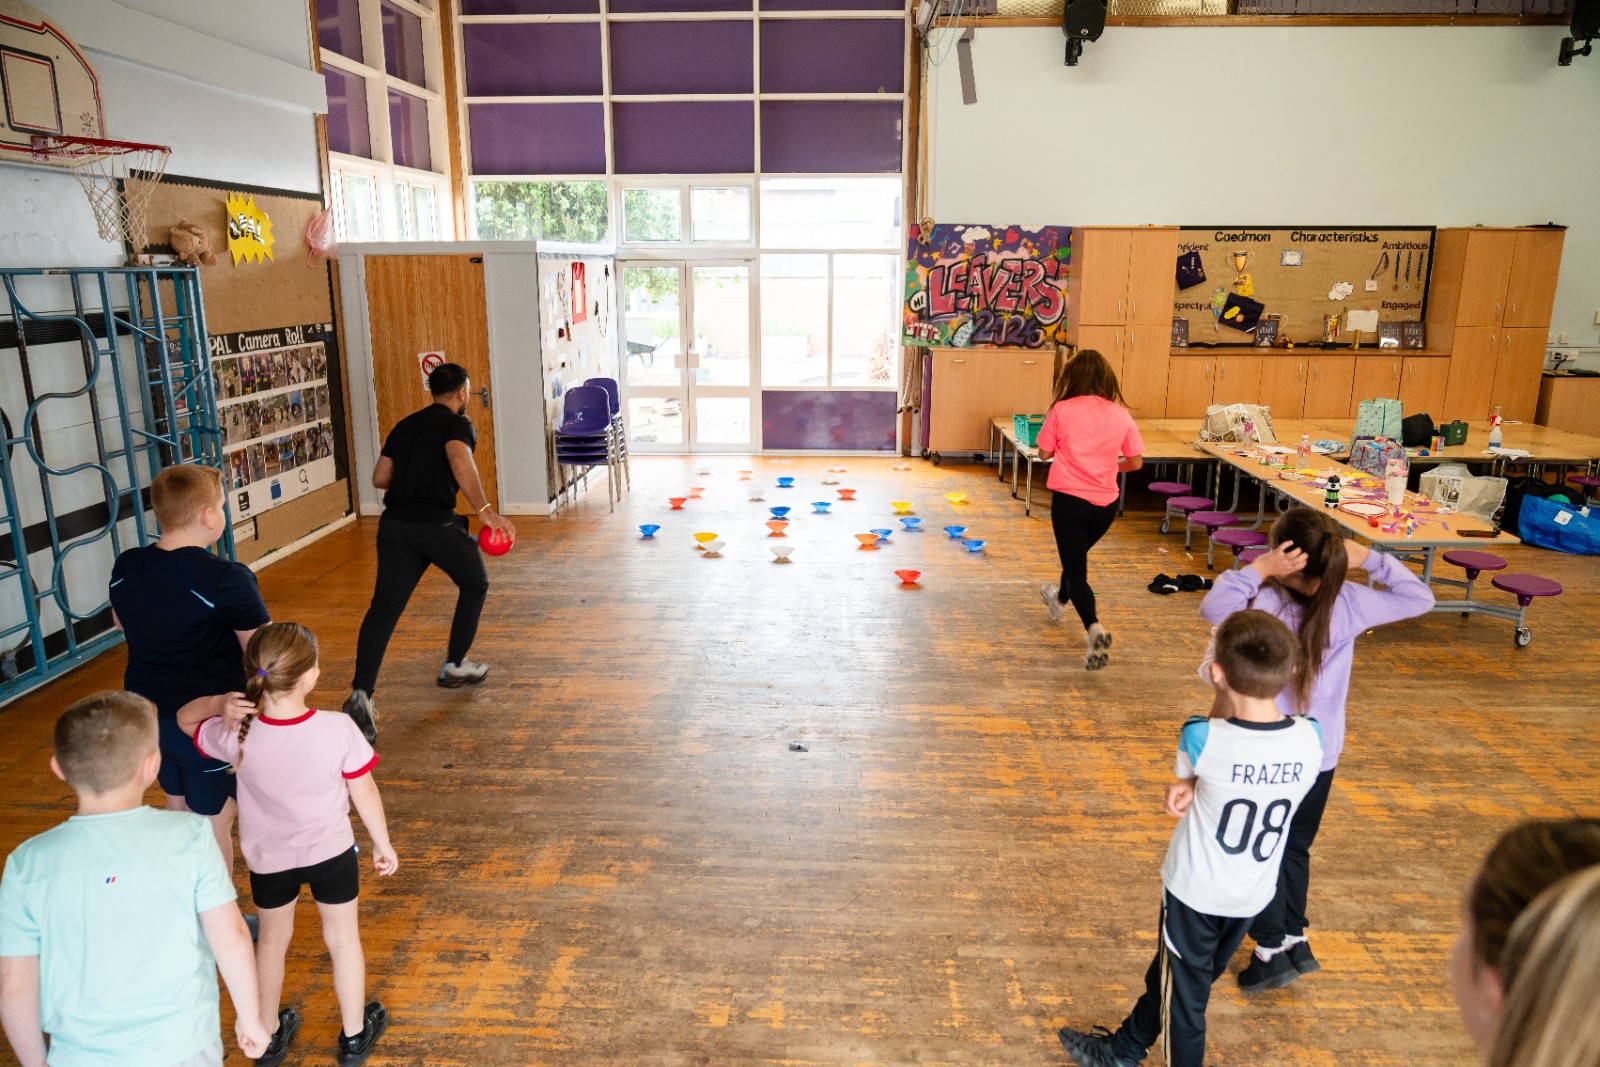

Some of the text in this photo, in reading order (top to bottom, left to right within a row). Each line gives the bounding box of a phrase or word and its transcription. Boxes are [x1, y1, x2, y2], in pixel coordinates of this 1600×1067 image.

[229, 212, 265, 245] OPAL
[1214, 231, 1379, 243] Caedmon Characteristics
[1177, 243, 1209, 252] nfident
[1381, 241, 1428, 250] Ambitious
[926, 253, 1066, 325] LEAVERS
[914, 295, 925, 307] HI
[1173, 302, 1212, 311] spectful
[1381, 301, 1421, 310] Engaged
[971, 309, 1047, 348] 2026
[207, 326, 305, 357] PAL Camera Roll
[1231, 762, 1303, 785] FRAZER
[1215, 798, 1292, 863] 08
